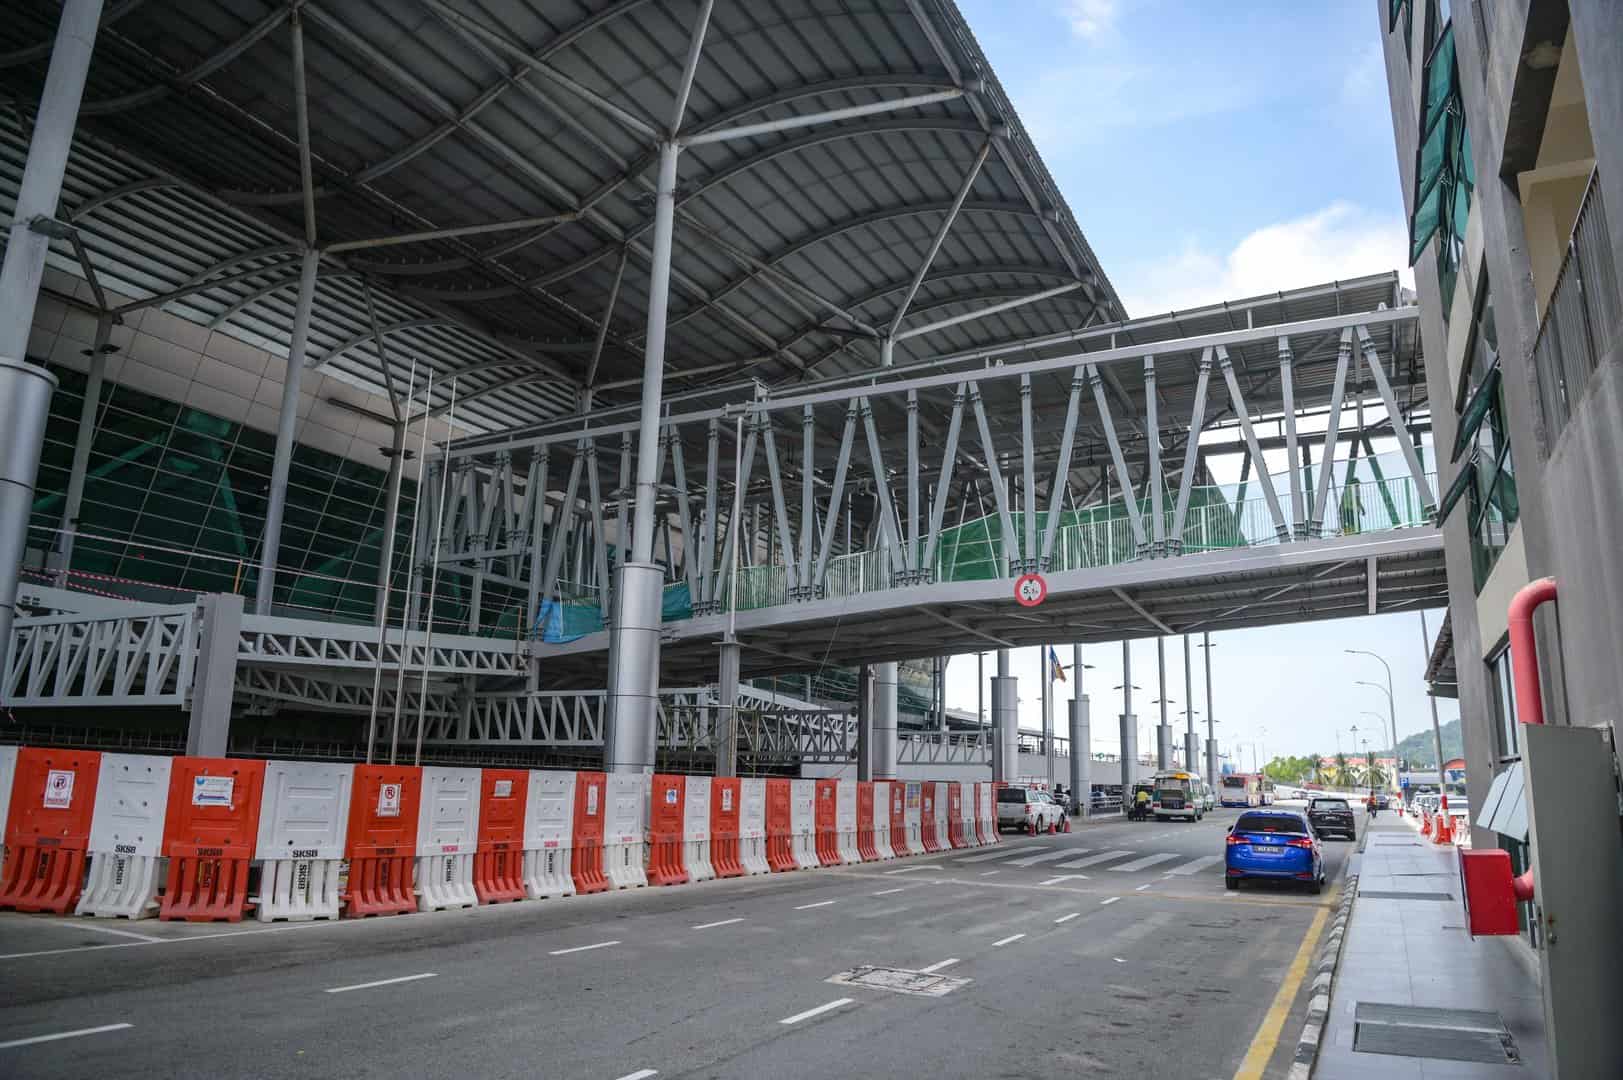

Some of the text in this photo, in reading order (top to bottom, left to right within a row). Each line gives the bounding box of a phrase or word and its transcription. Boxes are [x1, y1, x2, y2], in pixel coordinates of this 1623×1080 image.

[114, 844, 136, 854] SKSB
[197, 847, 222, 857] SKSB
[292, 849, 318, 857] SKSB
[117, 859, 125, 885] SKSB
[298, 864, 307, 890] SKSB
